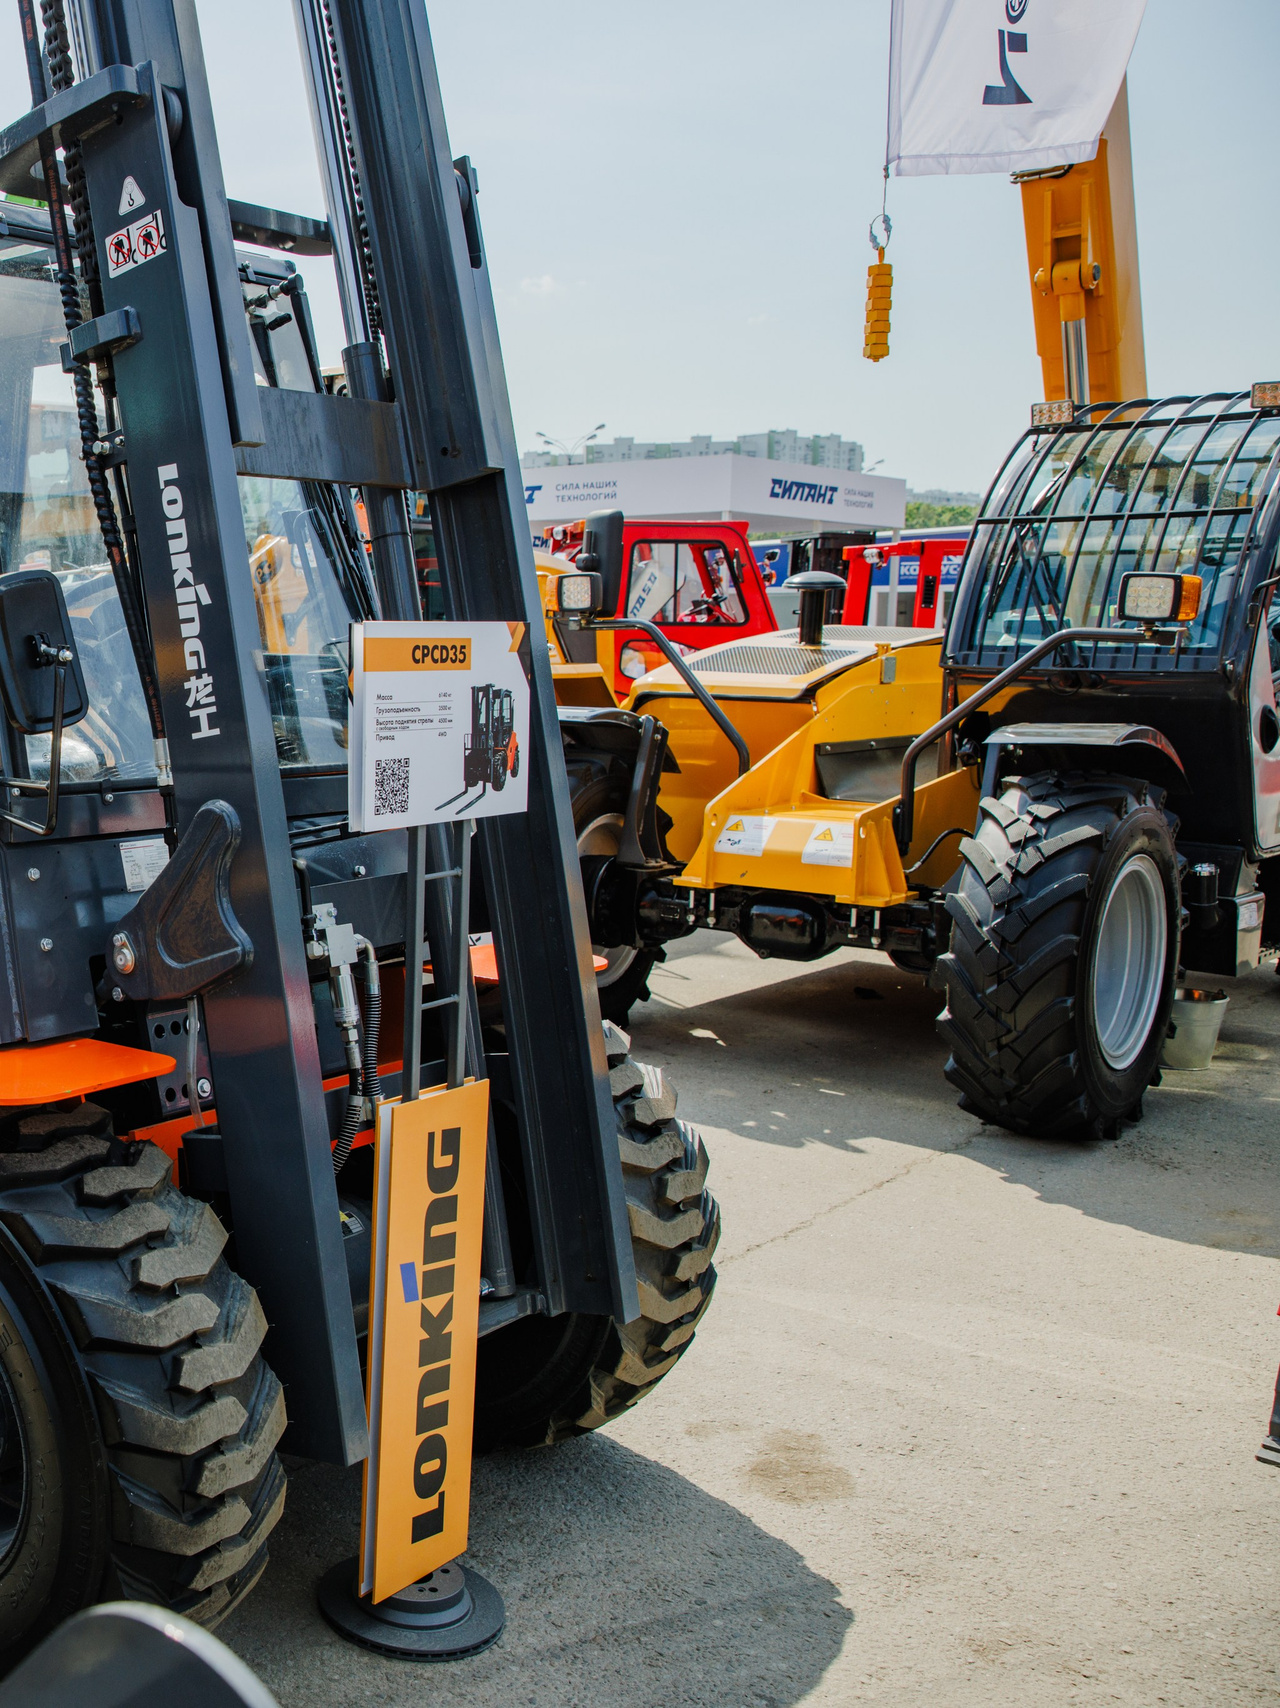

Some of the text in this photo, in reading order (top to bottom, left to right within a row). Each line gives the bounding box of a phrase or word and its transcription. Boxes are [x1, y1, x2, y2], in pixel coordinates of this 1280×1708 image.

[555, 480, 618, 492] СИЛА НАШИХ
[769, 478, 839, 505] СИЛАНТ
[555, 490, 618, 503] ТЕХНОЛОГИЙ
[411, 644, 467, 665] CPCD35
[375, 733, 395, 742] Привод
